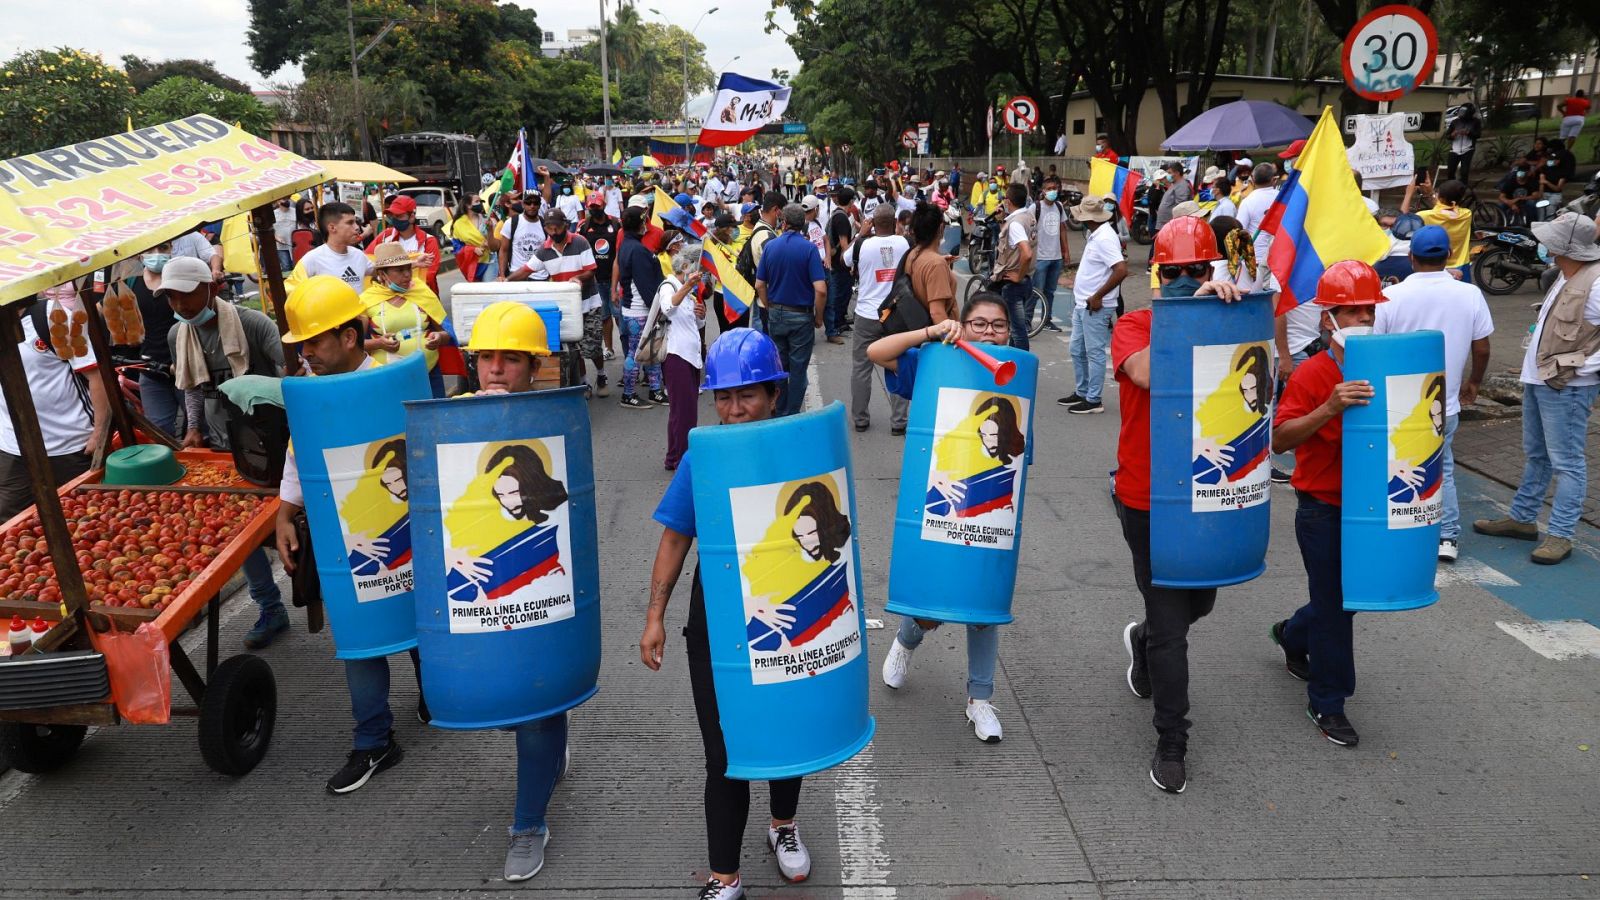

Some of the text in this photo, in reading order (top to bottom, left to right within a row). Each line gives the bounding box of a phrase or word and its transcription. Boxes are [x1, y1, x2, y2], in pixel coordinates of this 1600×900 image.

[1363, 32, 1417, 73] 30
[1014, 102, 1030, 127] P
[20, 188, 154, 229] 321
[142, 157, 250, 195] 592
[1196, 488, 1230, 498] PRIMERA
[1221, 497, 1235, 506] POR
[1391, 507, 1421, 516] PRIMERA
[925, 519, 957, 531] PRIMERA
[947, 531, 998, 544] POR COLOMBIA
[358, 576, 393, 590] PRIMERA
[385, 583, 401, 593] POR
[452, 594, 571, 617] PRIMERA LÍNEA ECUMÉNICA
[480, 610, 549, 627] POR COLOMBIA
[754, 630, 860, 668] PRIMERA LÍNEA ECUMÉNICA
[785, 650, 846, 675] POR COLOMBIA
